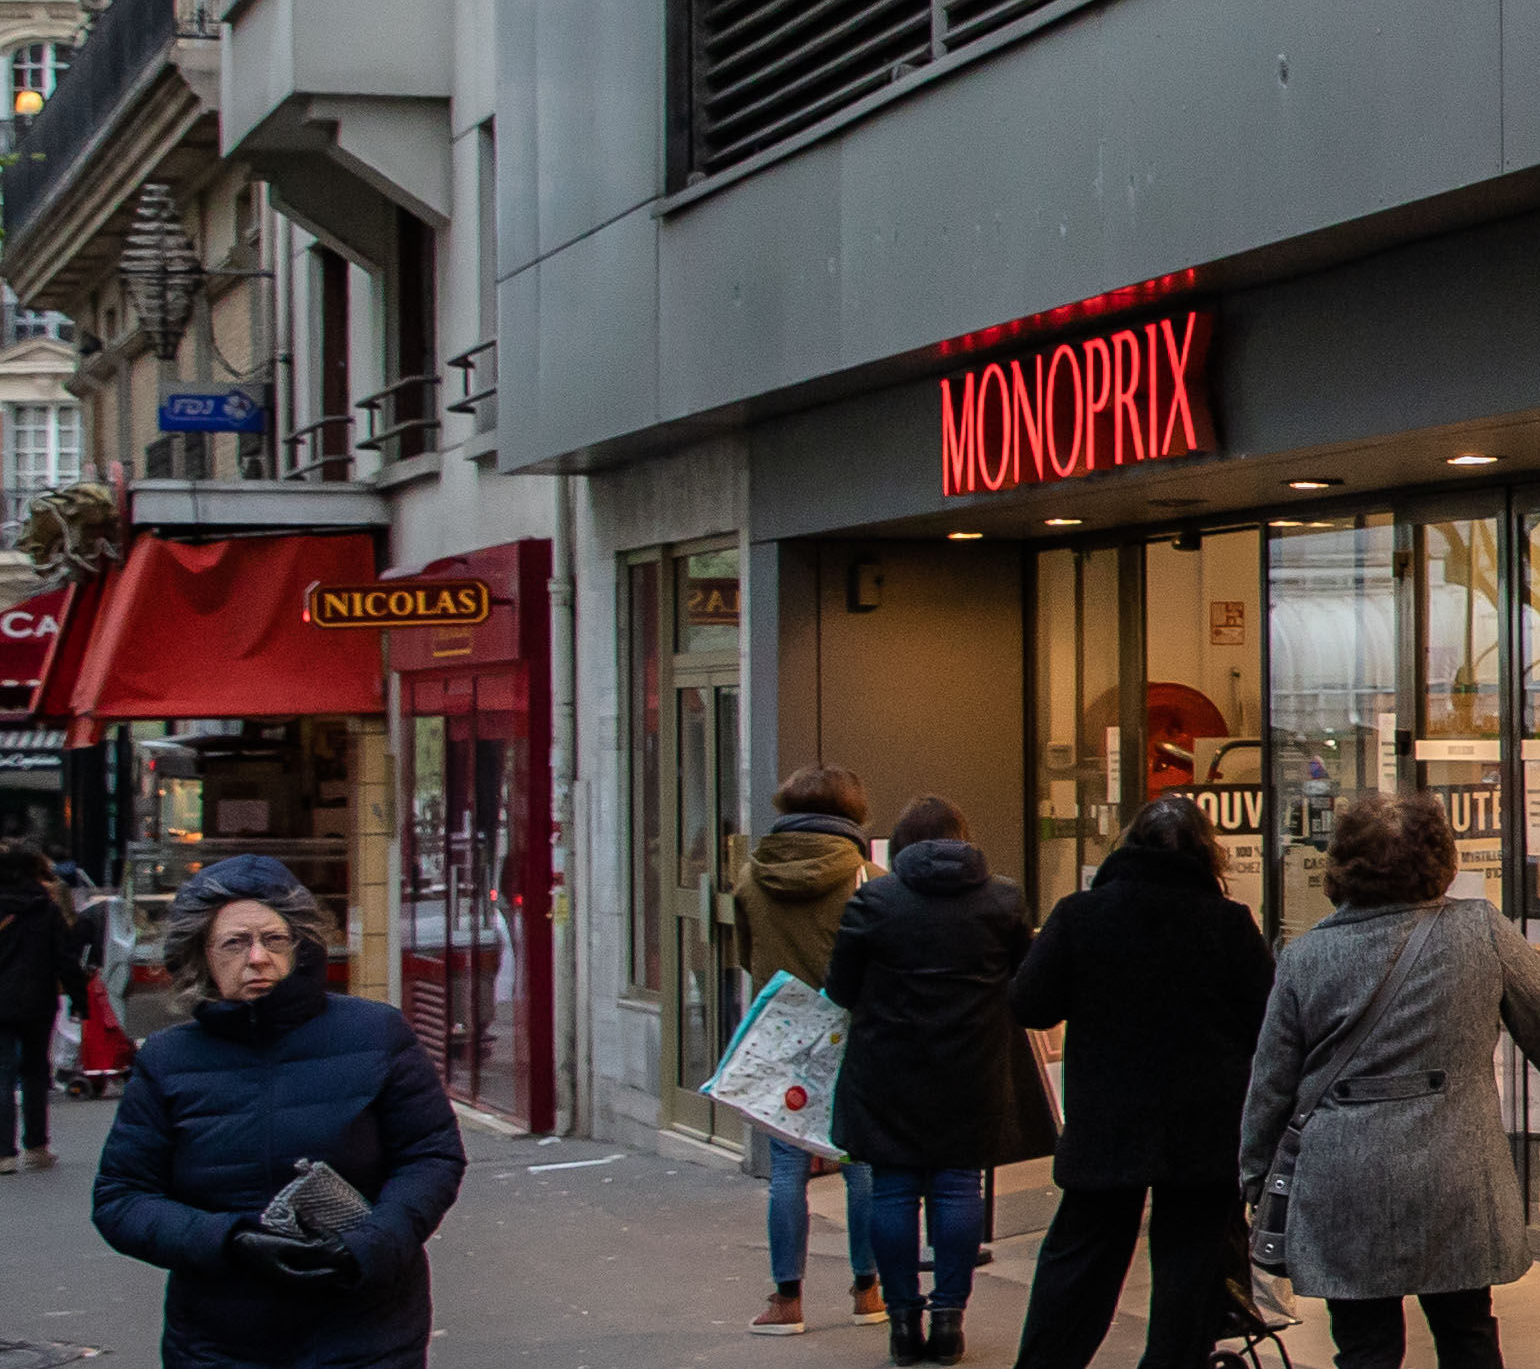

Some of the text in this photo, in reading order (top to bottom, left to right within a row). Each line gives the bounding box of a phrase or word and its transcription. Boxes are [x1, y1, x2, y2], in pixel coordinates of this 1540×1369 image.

[171, 397, 214, 416] FDJ
[941, 312, 1197, 496] MONOPRIX
[324, 590, 476, 617] NICOLAS
